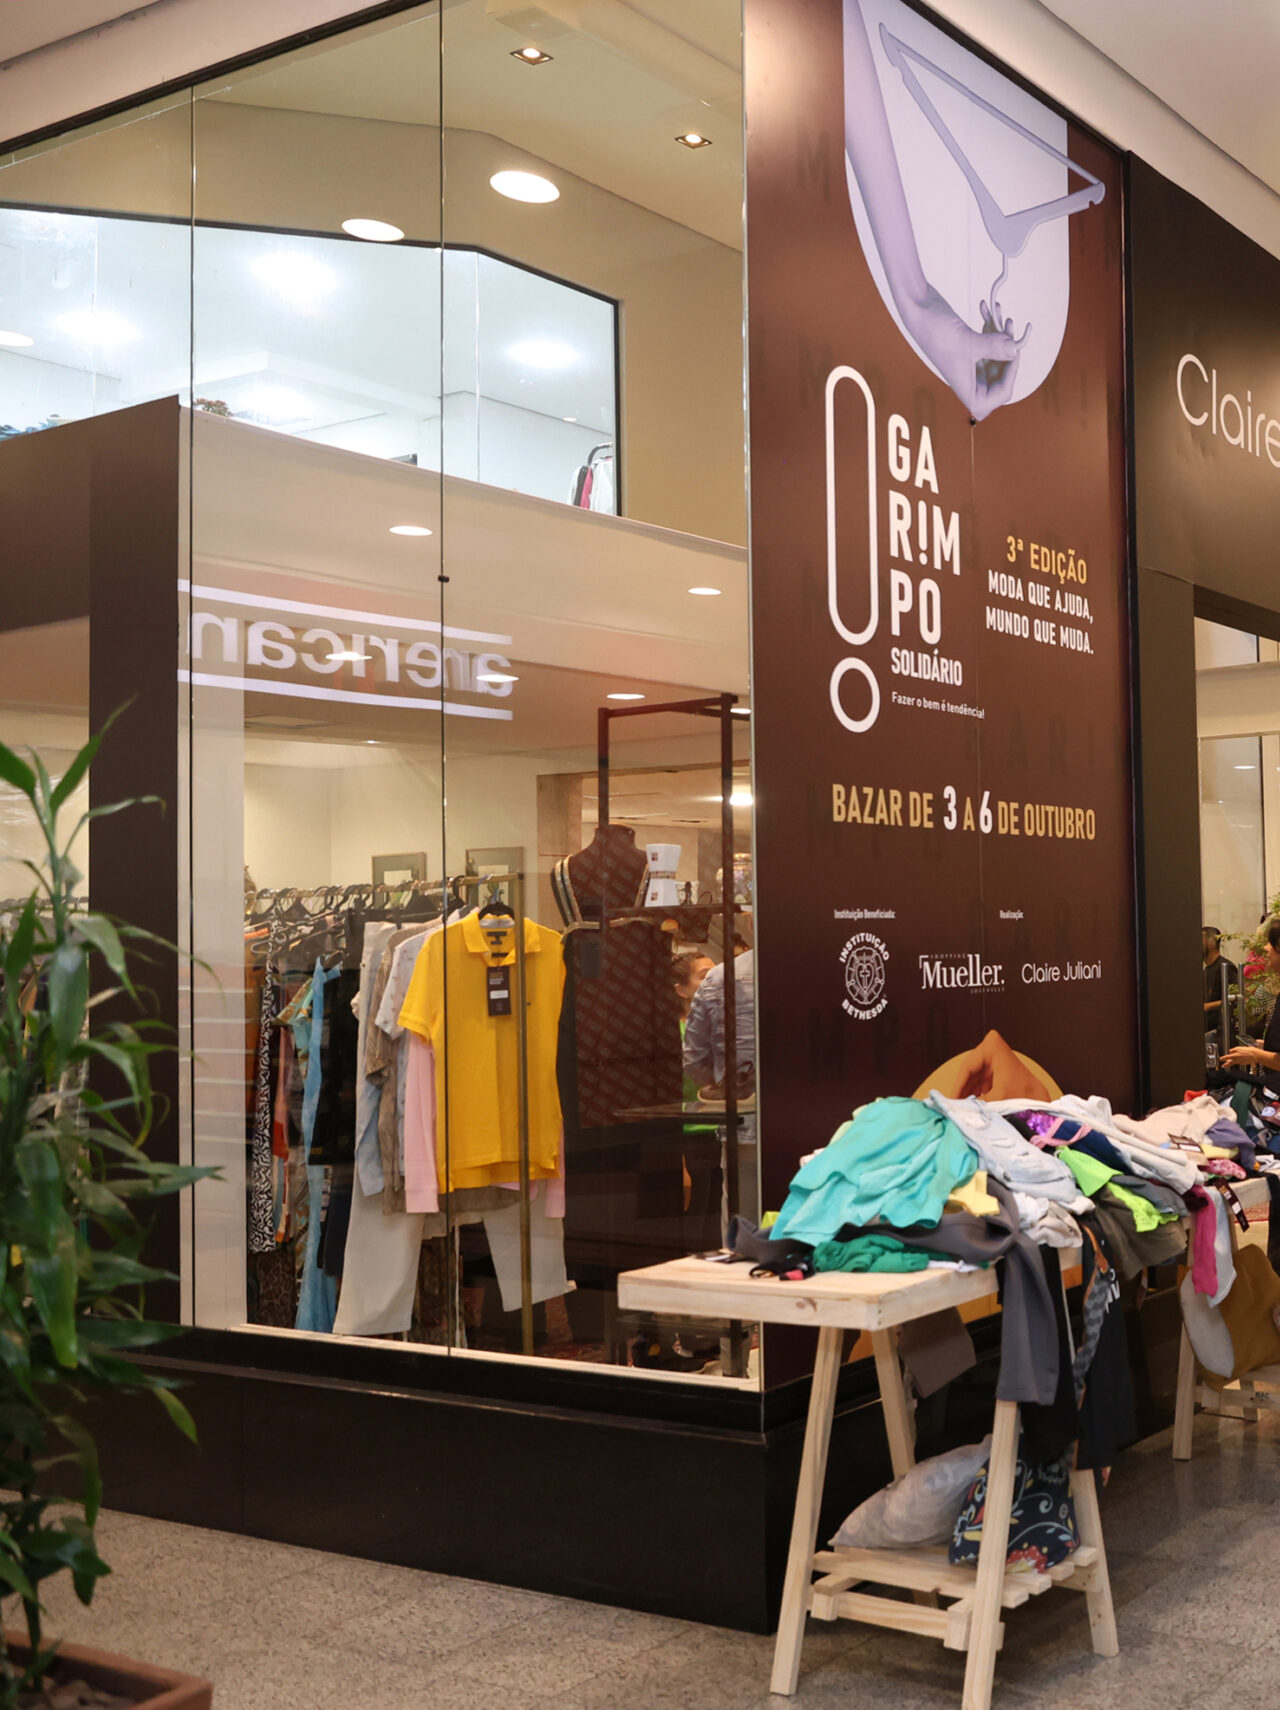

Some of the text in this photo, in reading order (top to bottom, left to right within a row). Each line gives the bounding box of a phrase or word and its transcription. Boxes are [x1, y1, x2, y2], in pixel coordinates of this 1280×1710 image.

[1030, 541, 1088, 585] EDIÇÃO
[988, 569, 1094, 625] MODA QUE AJUDA,
[985, 606, 1095, 656] MUNDO QUE MUDA.
[890, 646, 964, 687] SOLIDÁRIO
[891, 691, 986, 720] Fazer o bem é tendência!
[832, 783, 1096, 841] BAZAR DE 3 A 6 DE OUTUBRO
[838, 932, 890, 963] INSTITUIÇÃO
[1021, 960, 1102, 984] Claire Juliani
[841, 998, 888, 1021] BETHESDA
